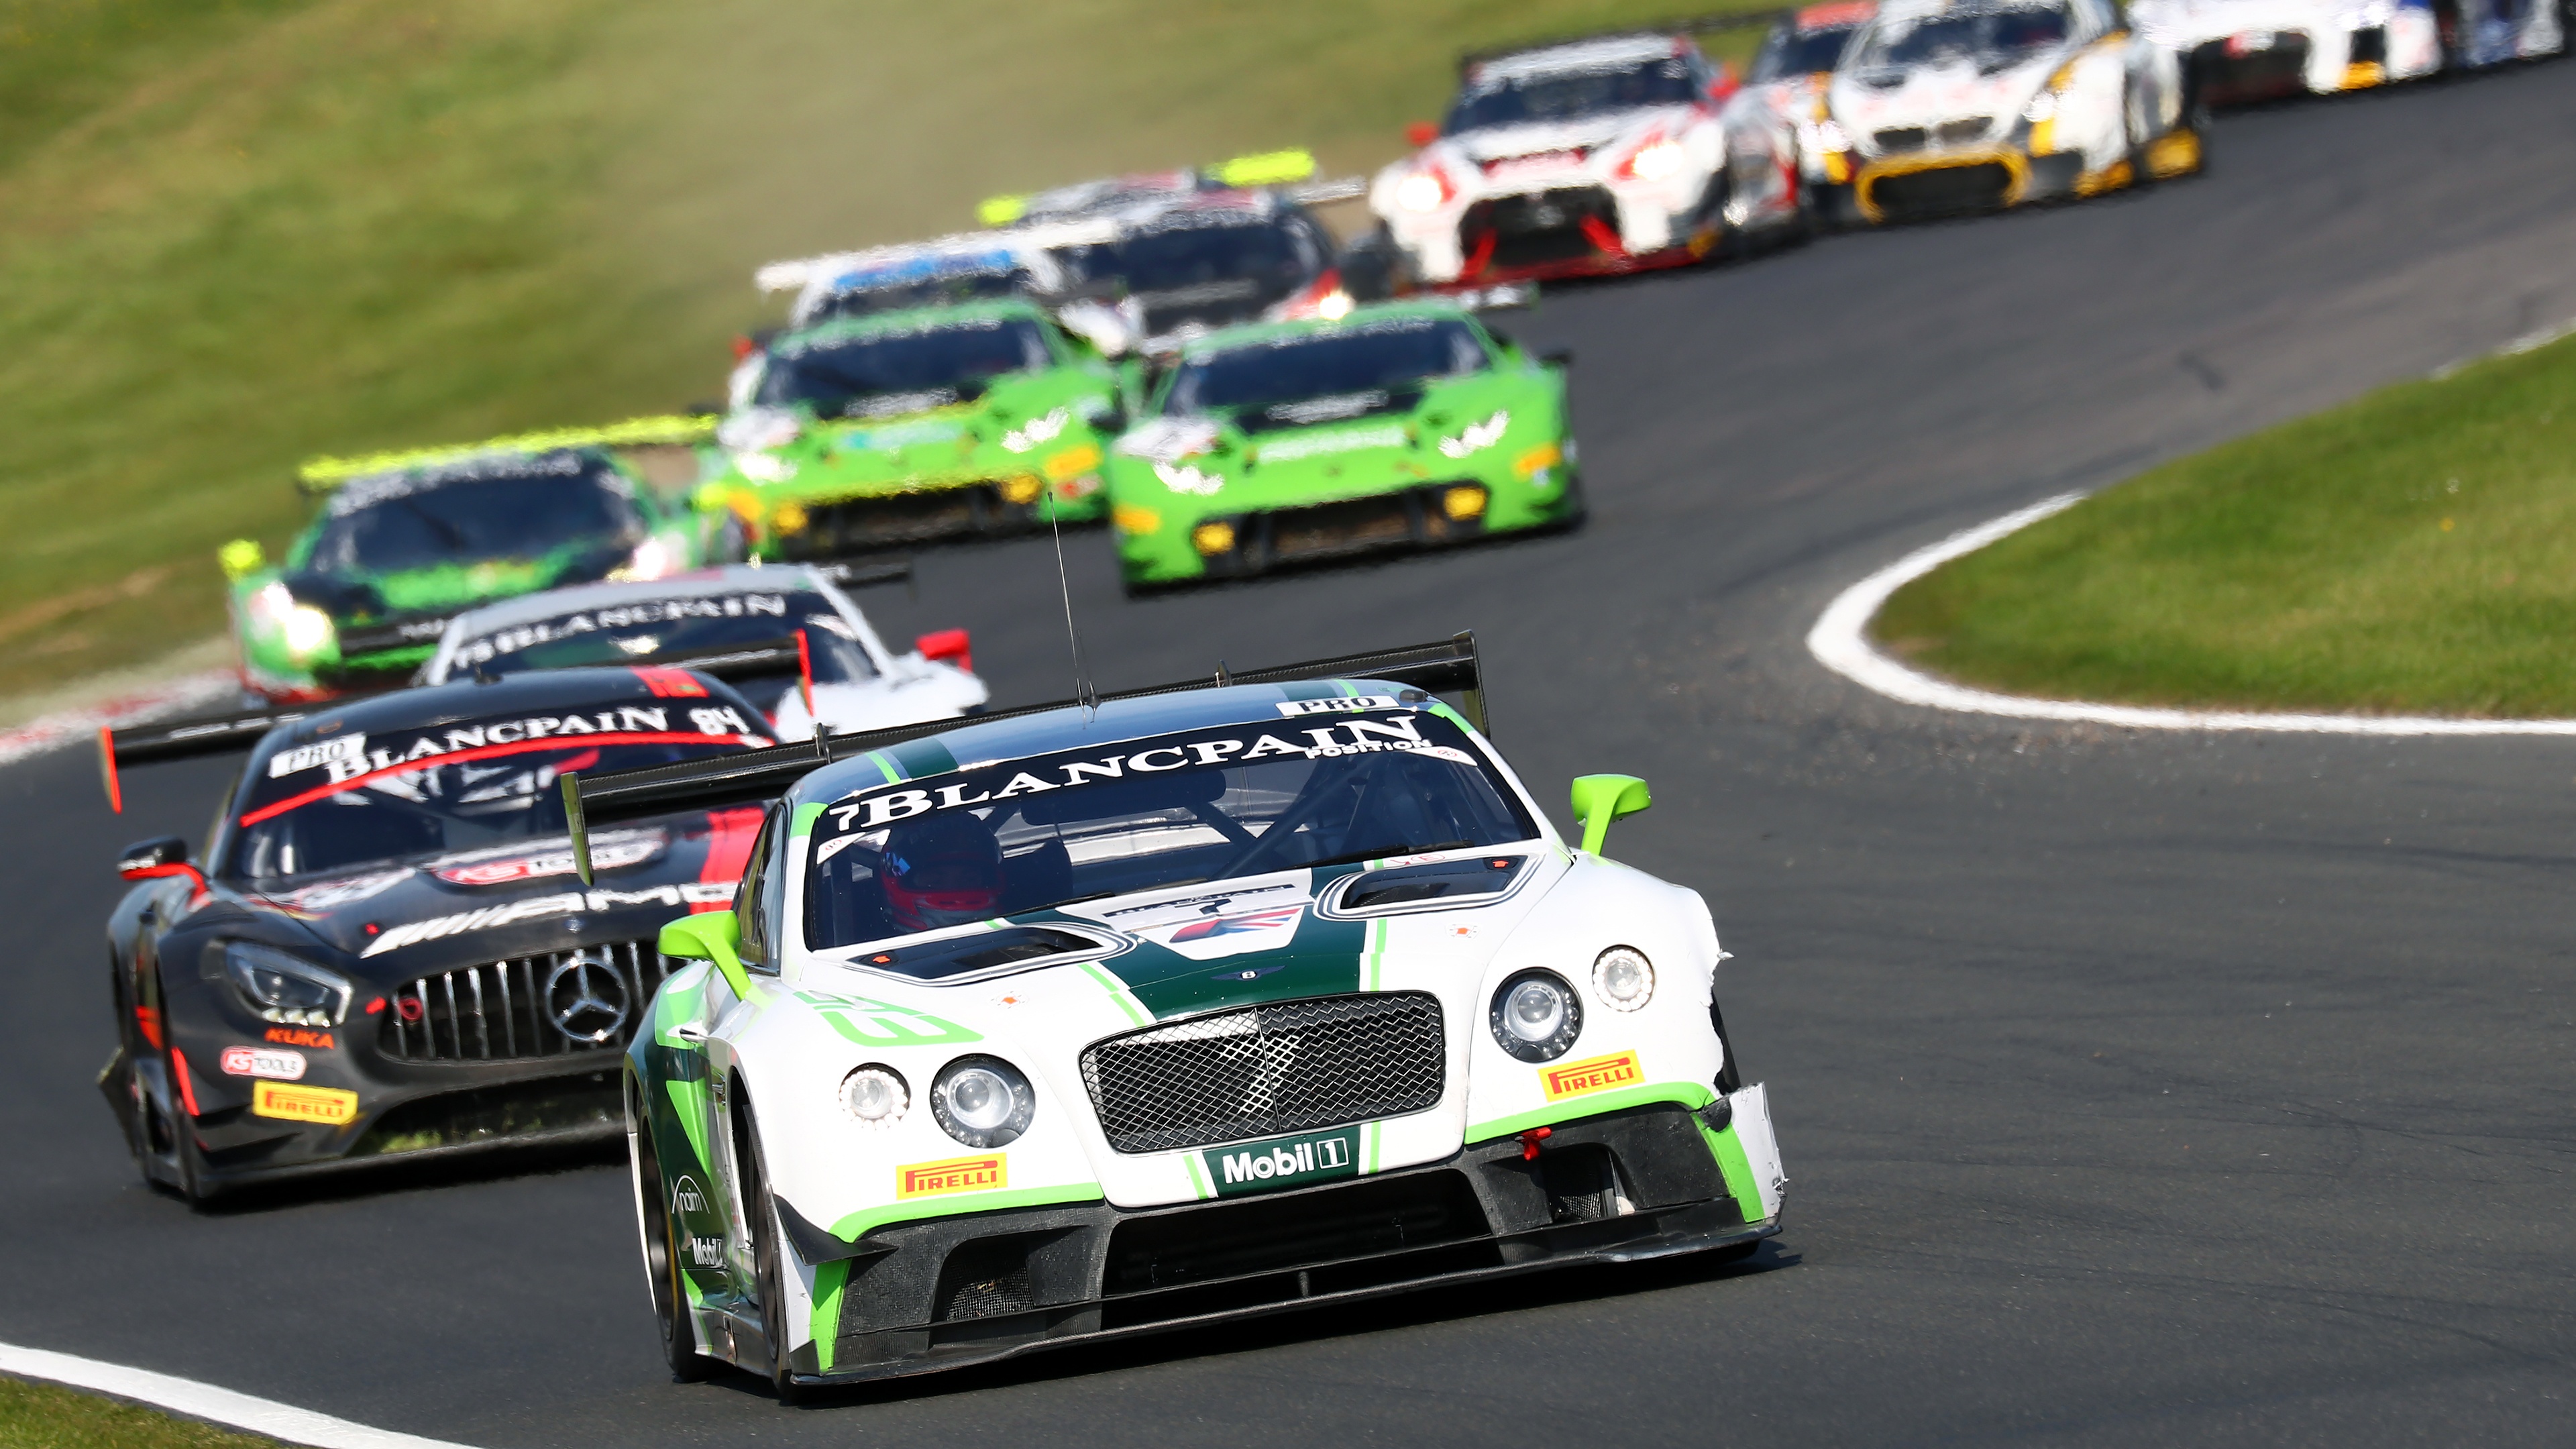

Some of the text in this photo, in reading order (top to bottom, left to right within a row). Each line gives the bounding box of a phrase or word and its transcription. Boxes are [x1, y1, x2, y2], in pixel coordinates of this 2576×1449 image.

[1298, 697, 1377, 712] PRO
[288, 741, 344, 772] PRO
[324, 706, 668, 785] BLANCPAIN
[688, 705, 751, 735] 84
[1305, 739, 1434, 759] POSITION
[828, 716, 1422, 832] 7 BLANCPAIN
[1174, 898, 1232, 914] 7
[264, 1027, 334, 1049] KUKA
[225, 1051, 252, 1071] KS
[1548, 1057, 1634, 1094] PIRELLI
[264, 1091, 344, 1117] PIRELLI
[905, 1160, 998, 1193] PIRELLI
[1222, 1142, 1315, 1184] Mobil
[678, 1187, 703, 1212] naim
[692, 1237, 717, 1266] Mobil
